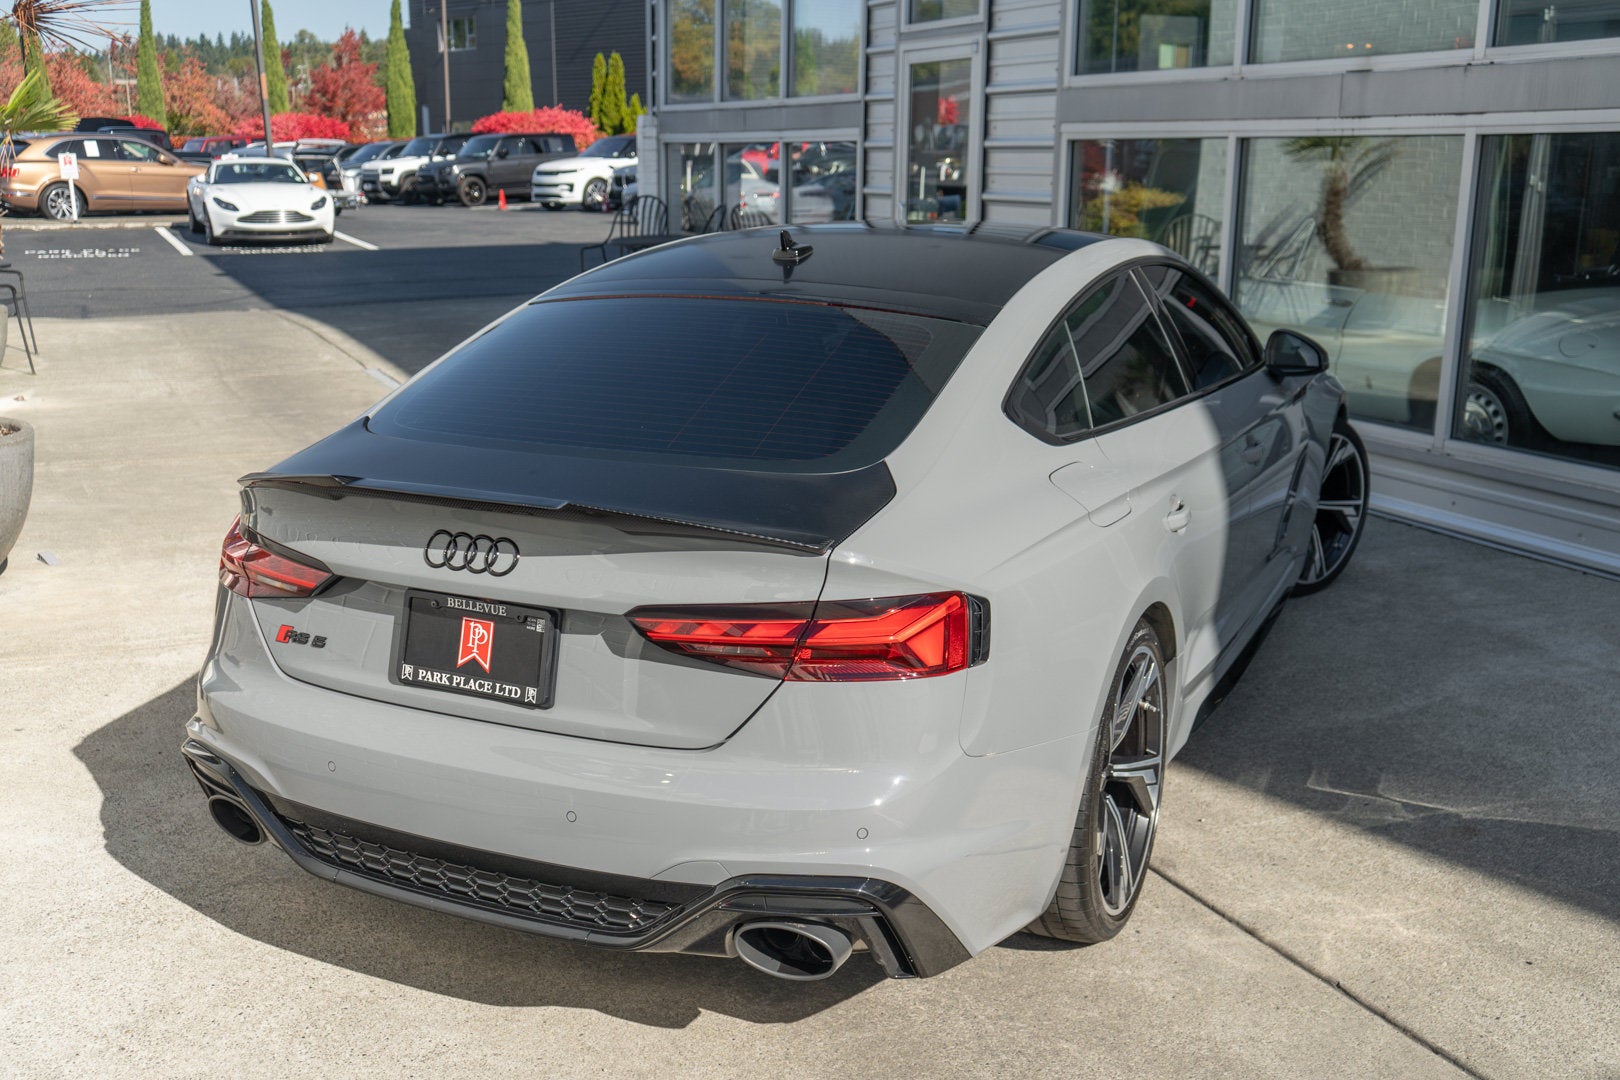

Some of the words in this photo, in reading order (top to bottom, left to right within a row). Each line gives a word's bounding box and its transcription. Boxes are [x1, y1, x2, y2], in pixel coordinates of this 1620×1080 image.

[447, 597, 507, 616] BELLEVUE
[280, 627, 311, 646] RS
[311, 635, 328, 649] 5
[418, 669, 451, 686] PARK
[452, 675, 493, 693] PLACE
[494, 682, 521, 699] LTD
